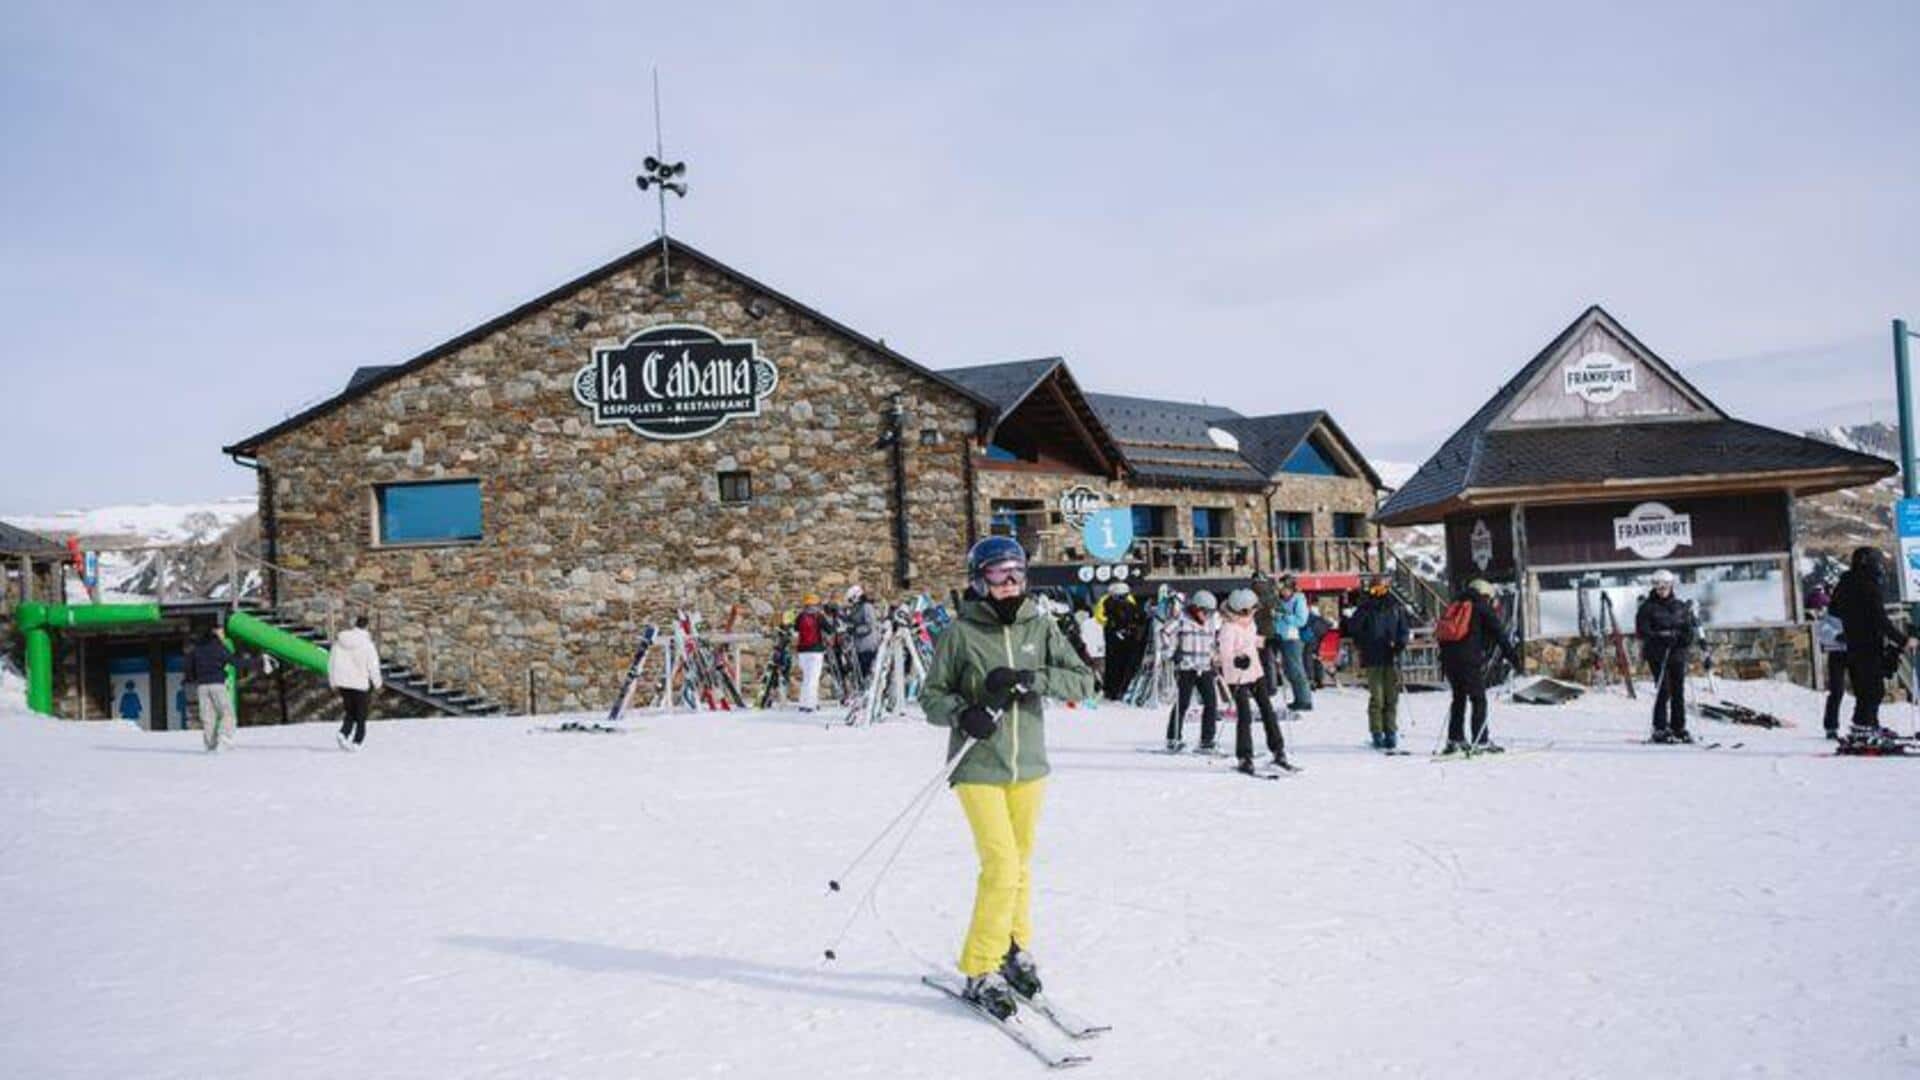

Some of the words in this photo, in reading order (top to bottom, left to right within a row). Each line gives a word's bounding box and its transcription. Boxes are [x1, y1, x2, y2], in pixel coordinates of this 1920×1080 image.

[602, 351, 627, 400] la
[642, 349, 750, 398] Cabana
[1567, 369, 1632, 388] FRANKFURT
[602, 402, 663, 415] ESPIOLETS
[675, 399, 751, 411] RESTAURANT
[1618, 520, 1688, 540] FRANKFURT
